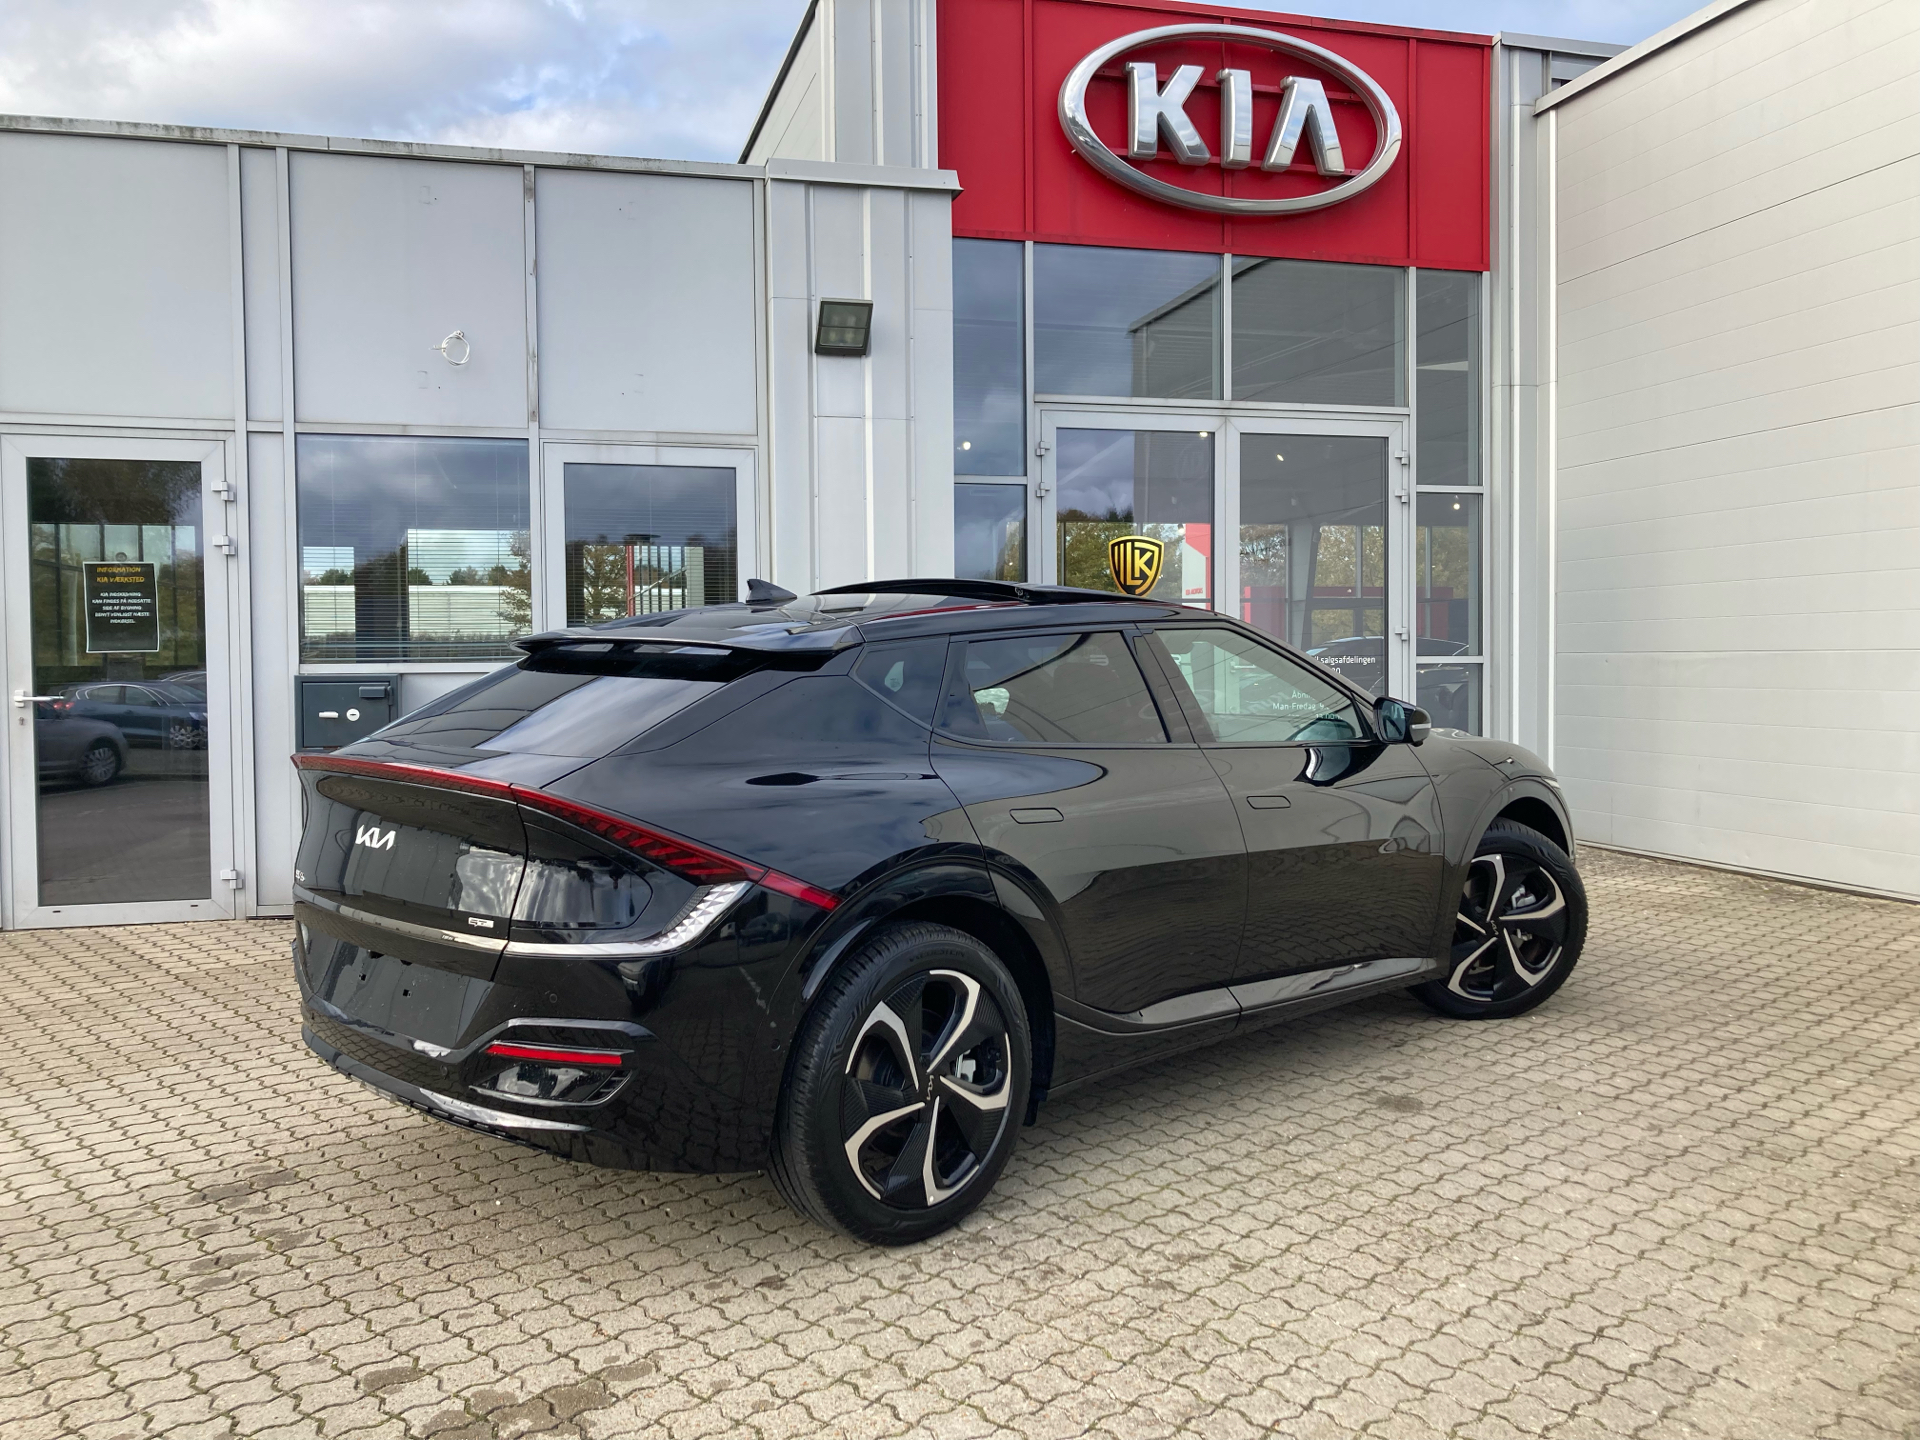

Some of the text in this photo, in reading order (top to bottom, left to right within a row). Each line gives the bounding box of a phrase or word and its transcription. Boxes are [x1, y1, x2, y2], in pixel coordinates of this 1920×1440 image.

[1123, 62, 1345, 177] KIA
[1320, 655, 1376, 666] salgsafdelingen
[355, 824, 397, 851] KIA
